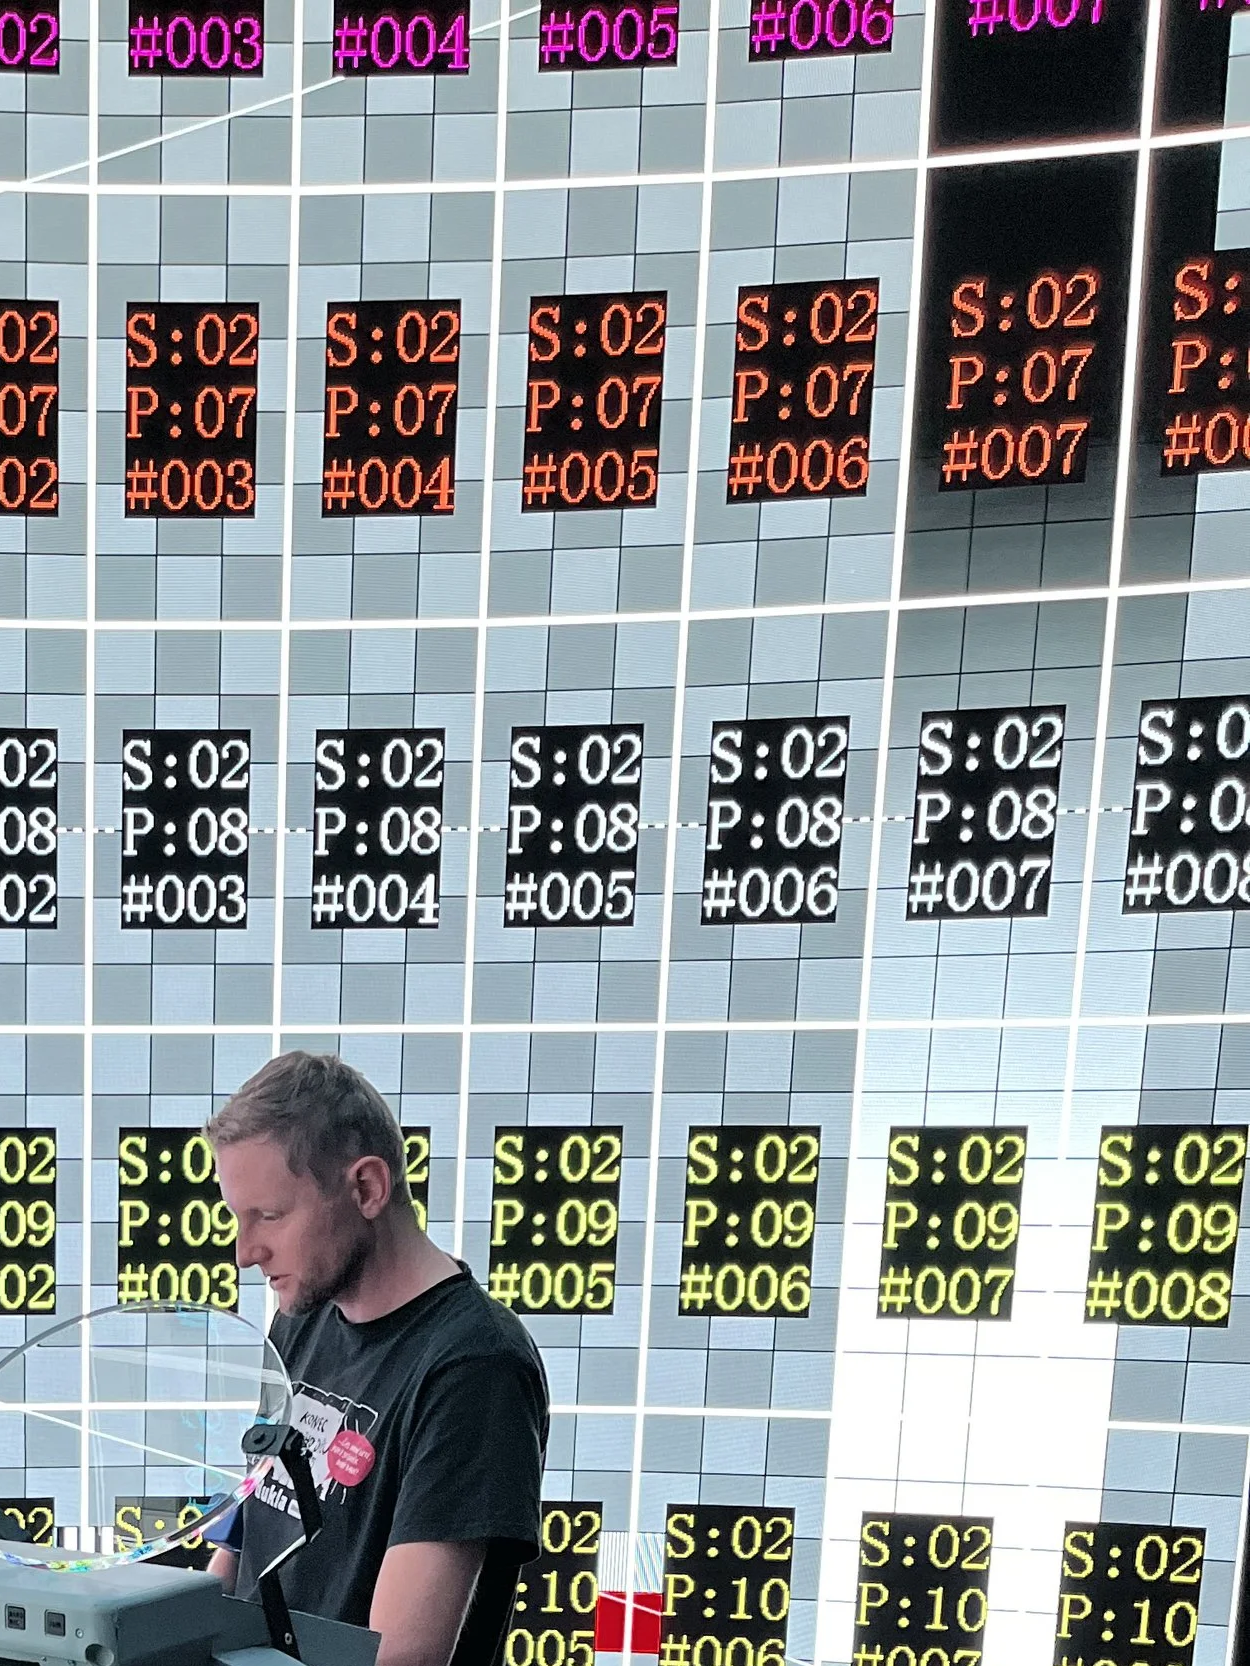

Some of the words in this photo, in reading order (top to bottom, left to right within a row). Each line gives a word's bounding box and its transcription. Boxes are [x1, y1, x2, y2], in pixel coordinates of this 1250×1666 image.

[129, 15, 262, 70] #003
[334, 14, 467, 69] #004
[541, 5, 675, 64] #005
[751, 0, 891, 53] #006
[737, 289, 875, 352] S:02
[951, 271, 1098, 338] S:02
[127, 312, 256, 368] S:02
[327, 310, 458, 367] S:02
[529, 302, 663, 362] S:02
[526, 375, 660, 433] P:07
[733, 361, 871, 423] P:07
[945, 345, 1094, 410] P:07
[126, 386, 255, 439] P:07
[325, 382, 456, 438] P:07
[524, 448, 657, 505] #005
[730, 436, 867, 496] #006
[941, 420, 1088, 484] #007
[126, 458, 253, 510] #003
[324, 456, 452, 510] #004
[511, 733, 640, 789] S:02
[711, 724, 845, 784] S:02
[919, 714, 1061, 776] S:02
[1138, 706, 1250, 766] S:0
[123, 739, 248, 791] S:02
[316, 738, 442, 791] S:02
[123, 807, 247, 857] P:08
[314, 806, 440, 856] P:08
[508, 802, 637, 855] P:08
[707, 795, 839, 851] P:08
[914, 785, 1055, 845] P:08
[1131, 778, 1250, 836] P:0
[123, 874, 245, 923] #003
[313, 873, 437, 924] #004
[506, 870, 634, 921] #005
[704, 865, 833, 918] #006
[911, 856, 1050, 914] #007
[118, 1136, 220, 1186] S:0
[494, 1134, 622, 1185] S:02
[687, 1133, 816, 1185] S:02
[891, 1134, 1019, 1186] S:02
[1102, 1133, 1242, 1187] S:02
[118, 1200, 239, 1247] P:09
[491, 1199, 618, 1246] P:09
[684, 1199, 810, 1248] P:09
[888, 1200, 1015, 1251] P:09
[1096, 1201, 1236, 1254] P:09
[118, 1262, 239, 1309] #003
[488, 1262, 615, 1313] #005
[682, 1262, 805, 1312] #006
[884, 1265, 1011, 1314] #007
[1090, 1267, 1230, 1321] #008
[665, 1513, 793, 1561] S:02
[861, 1521, 988, 1569] S:02
[1061, 1532, 1201, 1582] S:02
[661, 1573, 789, 1621] P:10
[858, 1583, 985, 1631] P:10
[1057, 1594, 1196, 1646] P:10
